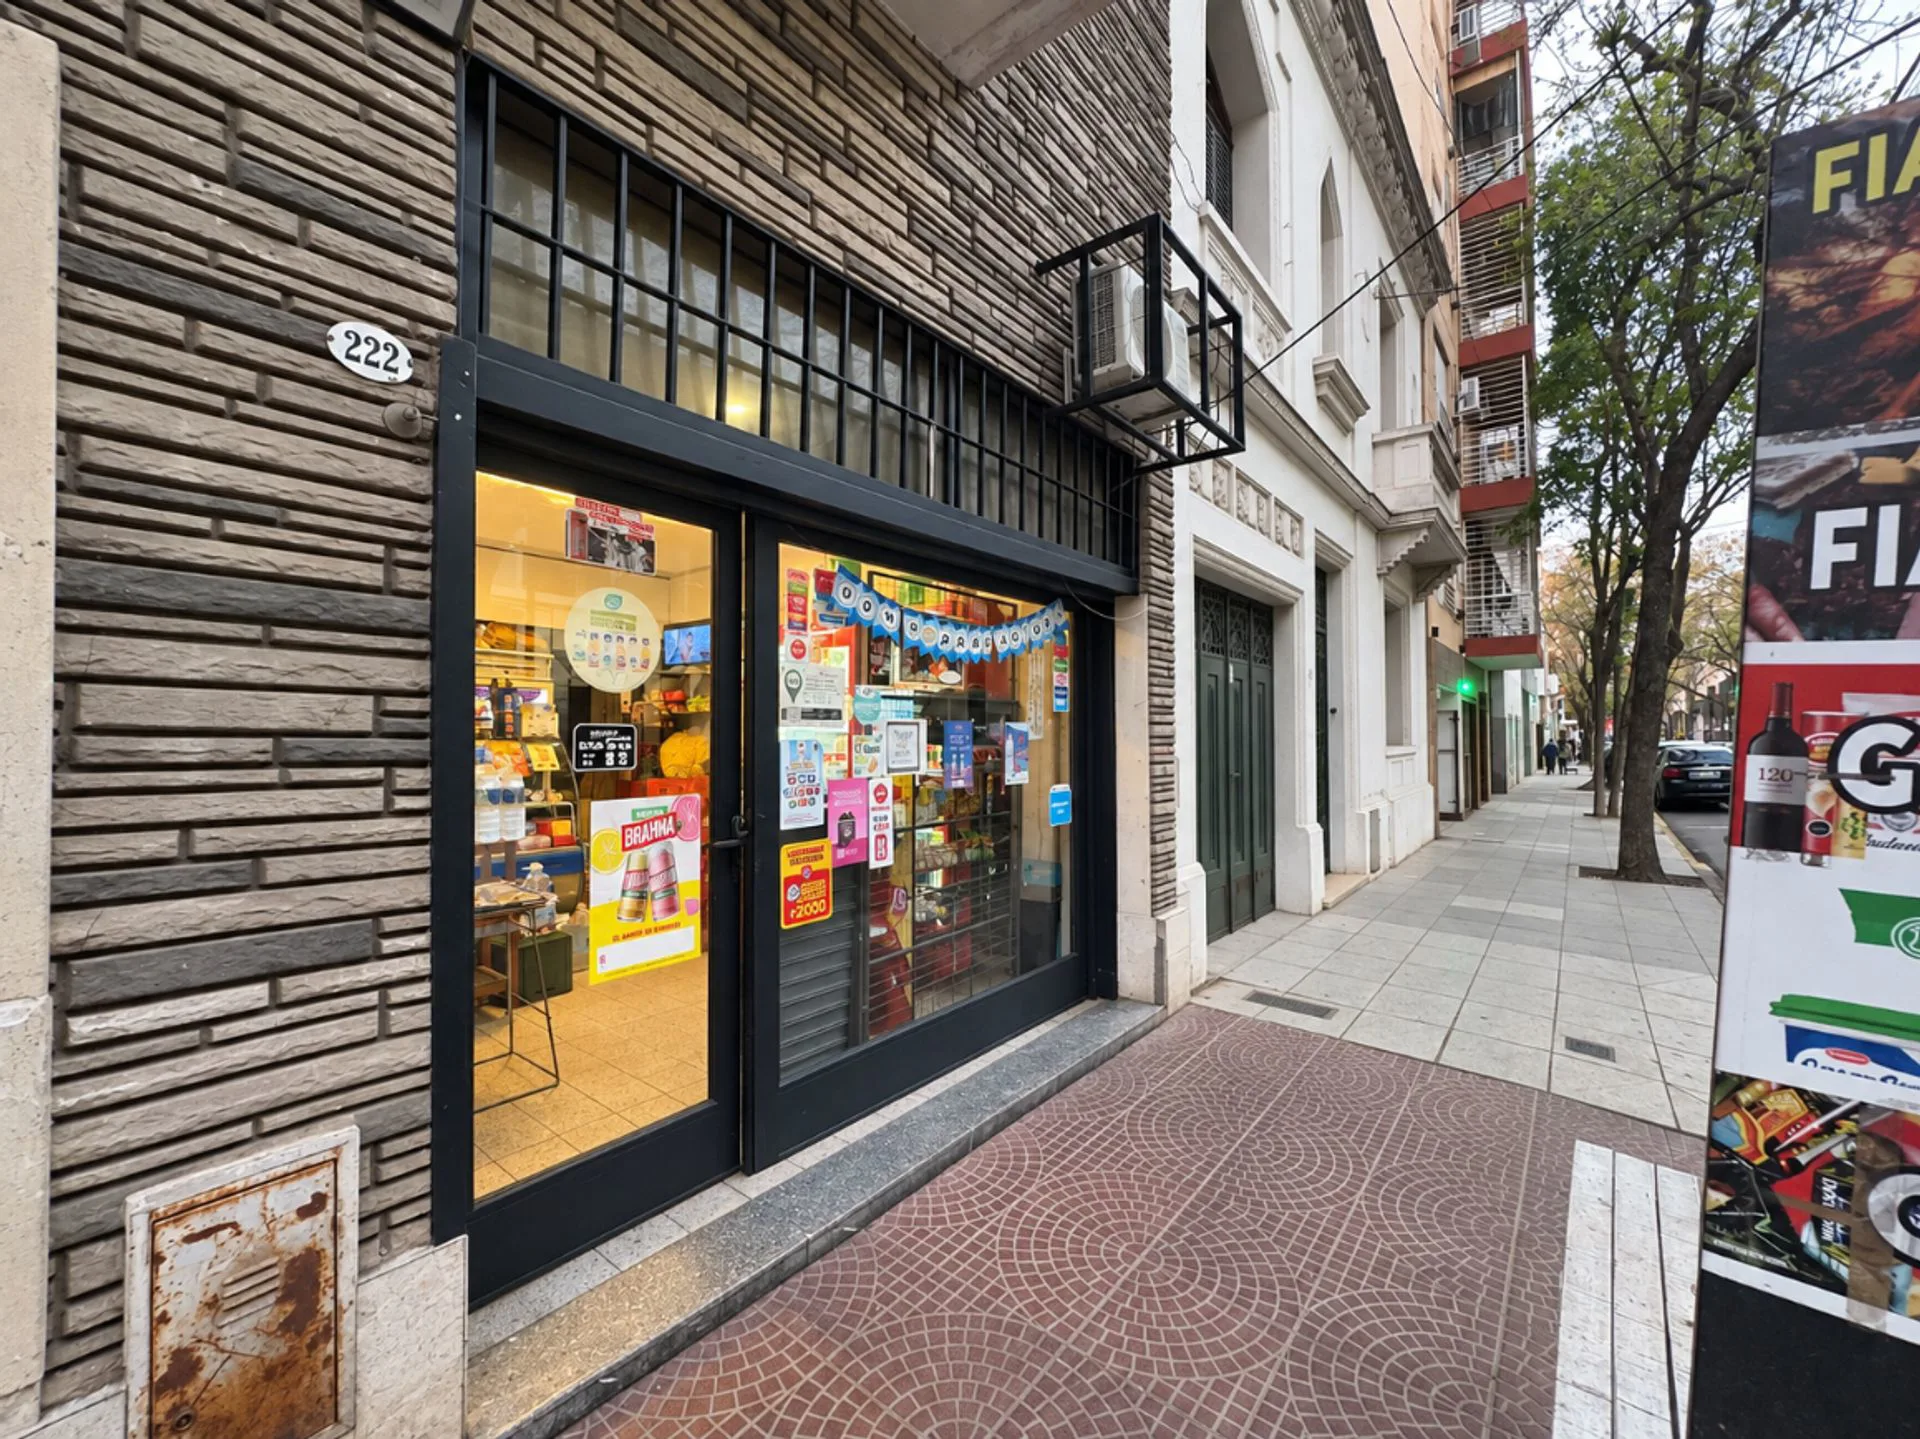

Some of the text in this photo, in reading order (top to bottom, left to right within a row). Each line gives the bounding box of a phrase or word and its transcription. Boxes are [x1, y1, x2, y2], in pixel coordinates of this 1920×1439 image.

[344, 329, 399, 374] 222
[1810, 504, 1920, 590] FI
[1758, 767, 1794, 783] 120
[625, 815, 674, 847] BRAHMA
